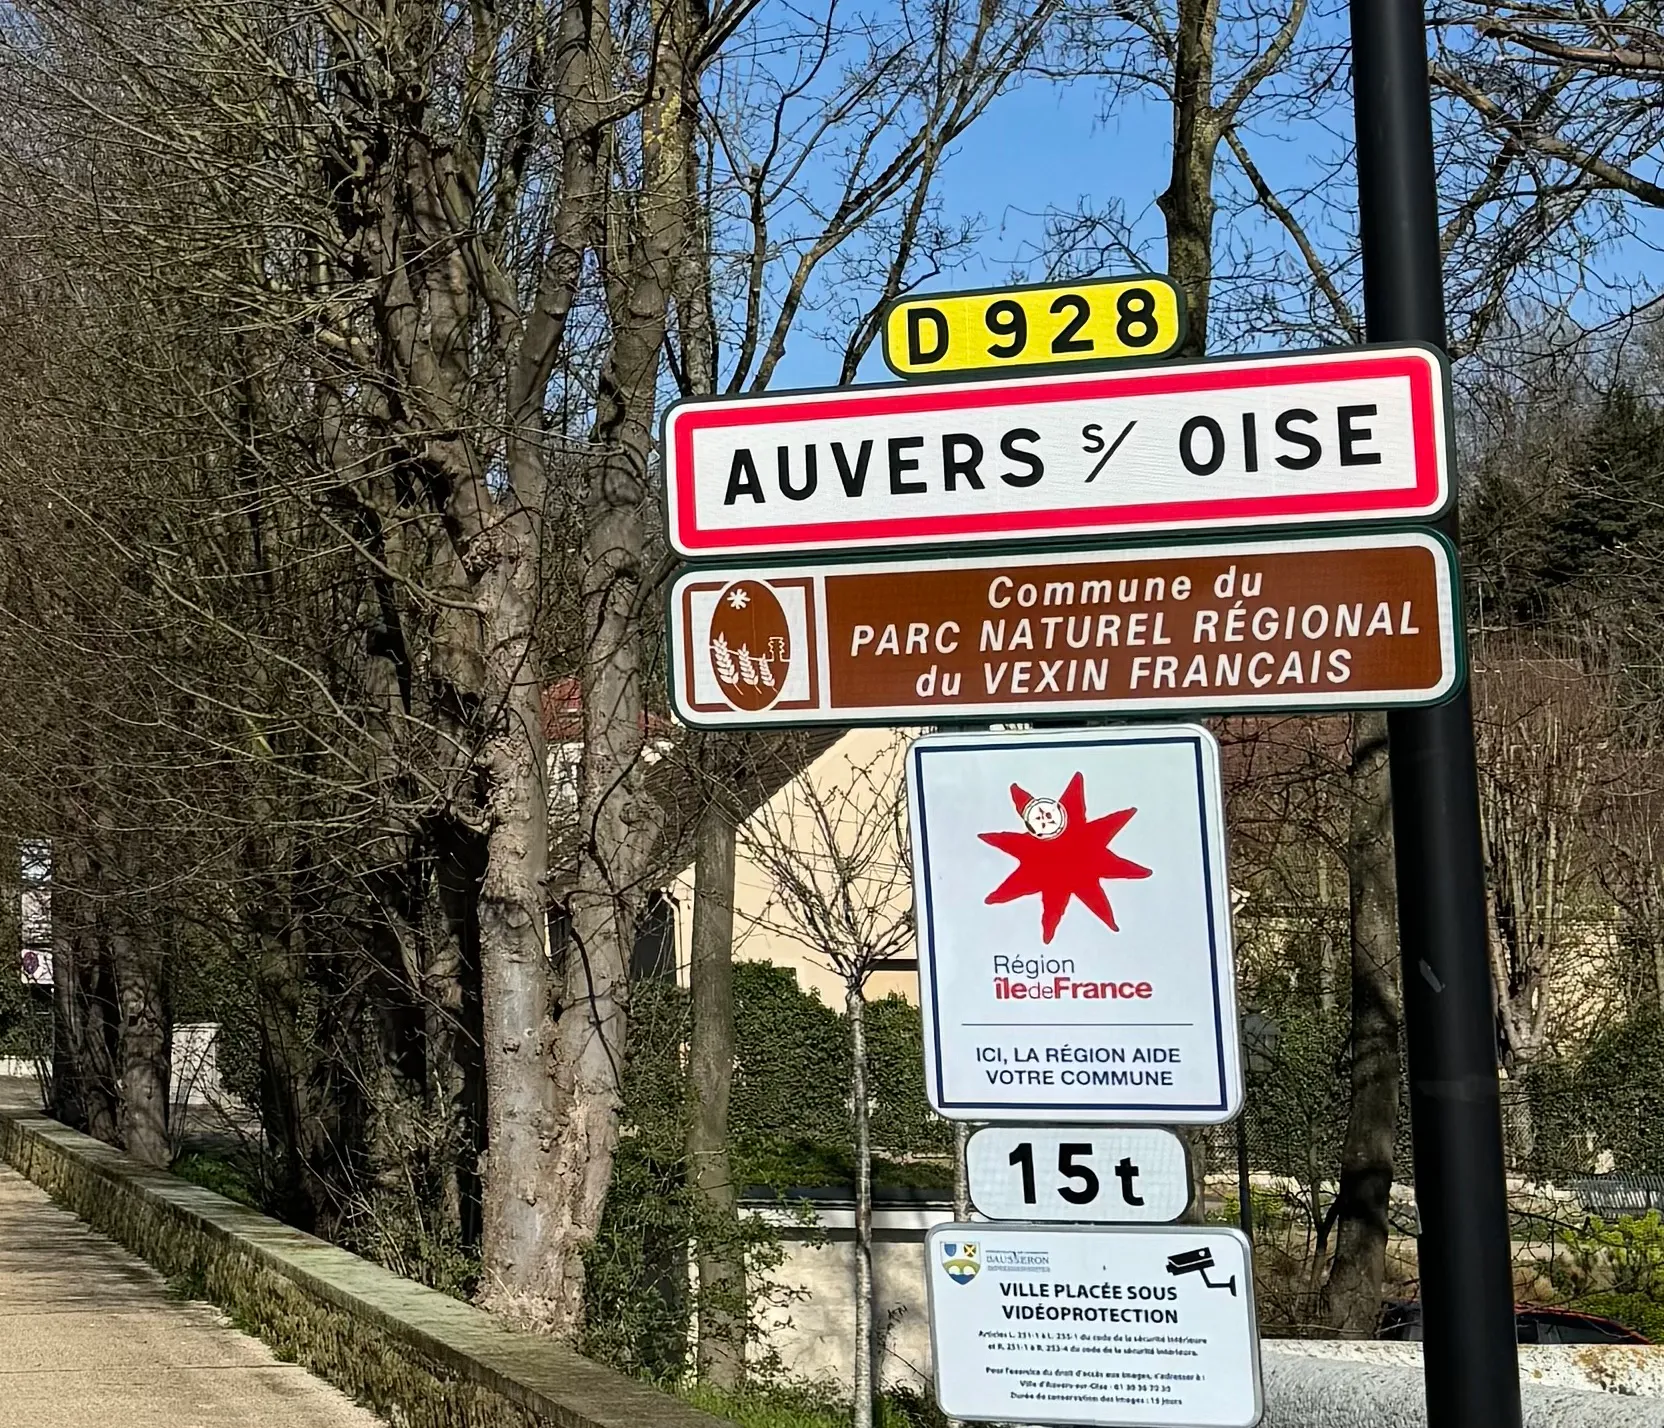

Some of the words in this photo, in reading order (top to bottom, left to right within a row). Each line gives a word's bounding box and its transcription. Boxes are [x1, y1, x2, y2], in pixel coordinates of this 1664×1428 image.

[906, 306, 950, 365] D
[985, 287, 1159, 359] 928
[723, 426, 1045, 506] AUVERS
[1178, 403, 1382, 477] OISE
[988, 576, 1191, 609] Commune
[1214, 565, 1263, 599] du
[851, 621, 961, 657] PARC
[979, 612, 1171, 652] NATUREL
[1193, 601, 1420, 645] RÉGIONAL
[915, 666, 962, 698] du
[985, 659, 1109, 695] VEXIN
[1130, 649, 1352, 690] FRANÇAIS
[993, 954, 1075, 979] Région
[976, 1047, 1008, 1065] ICI,
[1014, 1047, 1040, 1063] LA
[1046, 1043, 1125, 1063] RÉGION
[1132, 1047, 1181, 1063] AIDE
[985, 1070, 1055, 1085] VOTRE
[1061, 1070, 1174, 1086] COMMUNE
[1000, 1282, 1049, 1298] VILLE
[1054, 1281, 1122, 1299] PLACÉE
[1127, 1285, 1177, 1300] SOUS
[1002, 1303, 1178, 1324] VIDÉOPROTECTION
